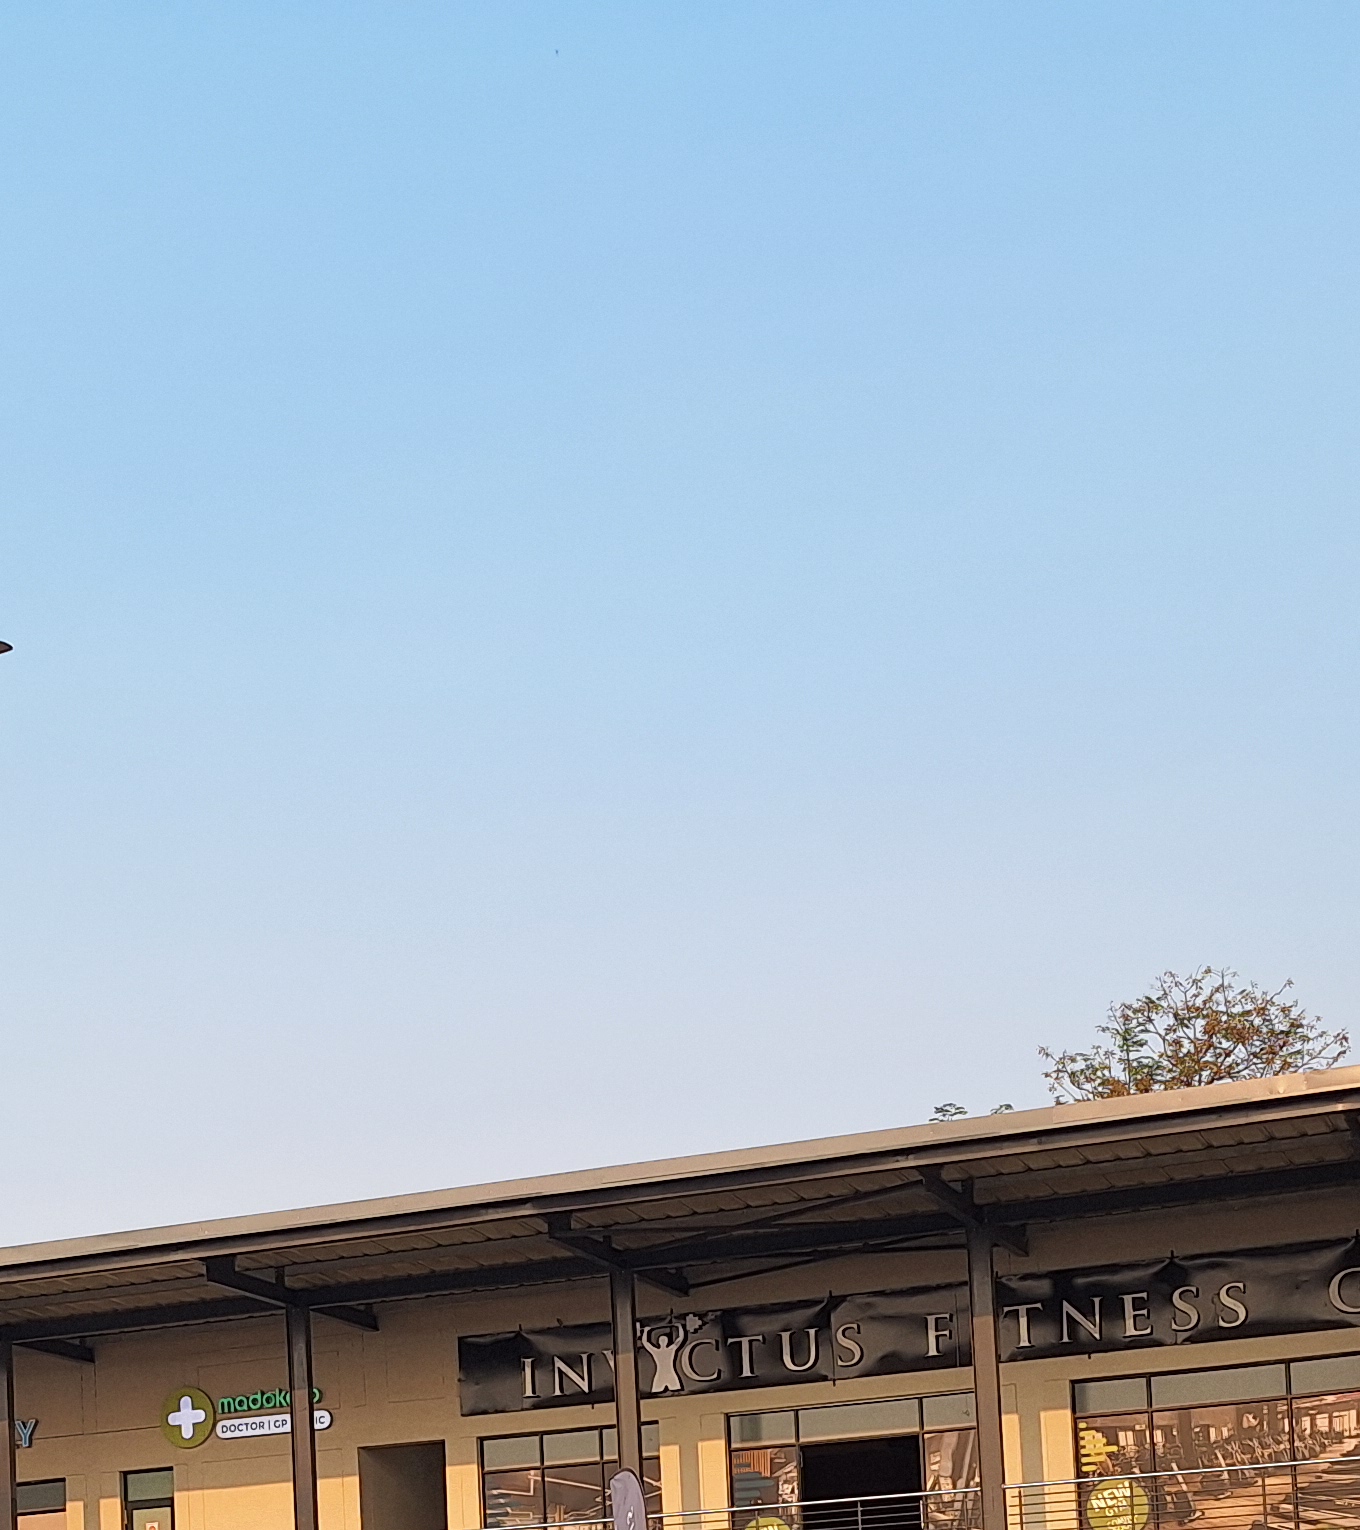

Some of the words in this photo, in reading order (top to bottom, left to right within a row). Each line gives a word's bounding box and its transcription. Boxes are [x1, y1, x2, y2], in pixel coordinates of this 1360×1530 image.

[924, 1281, 1251, 1359] FTNESS
[221, 1421, 265, 1434] DOCTOR
[273, 1418, 288, 1429] GP
[1090, 1480, 1131, 1513] NEW
